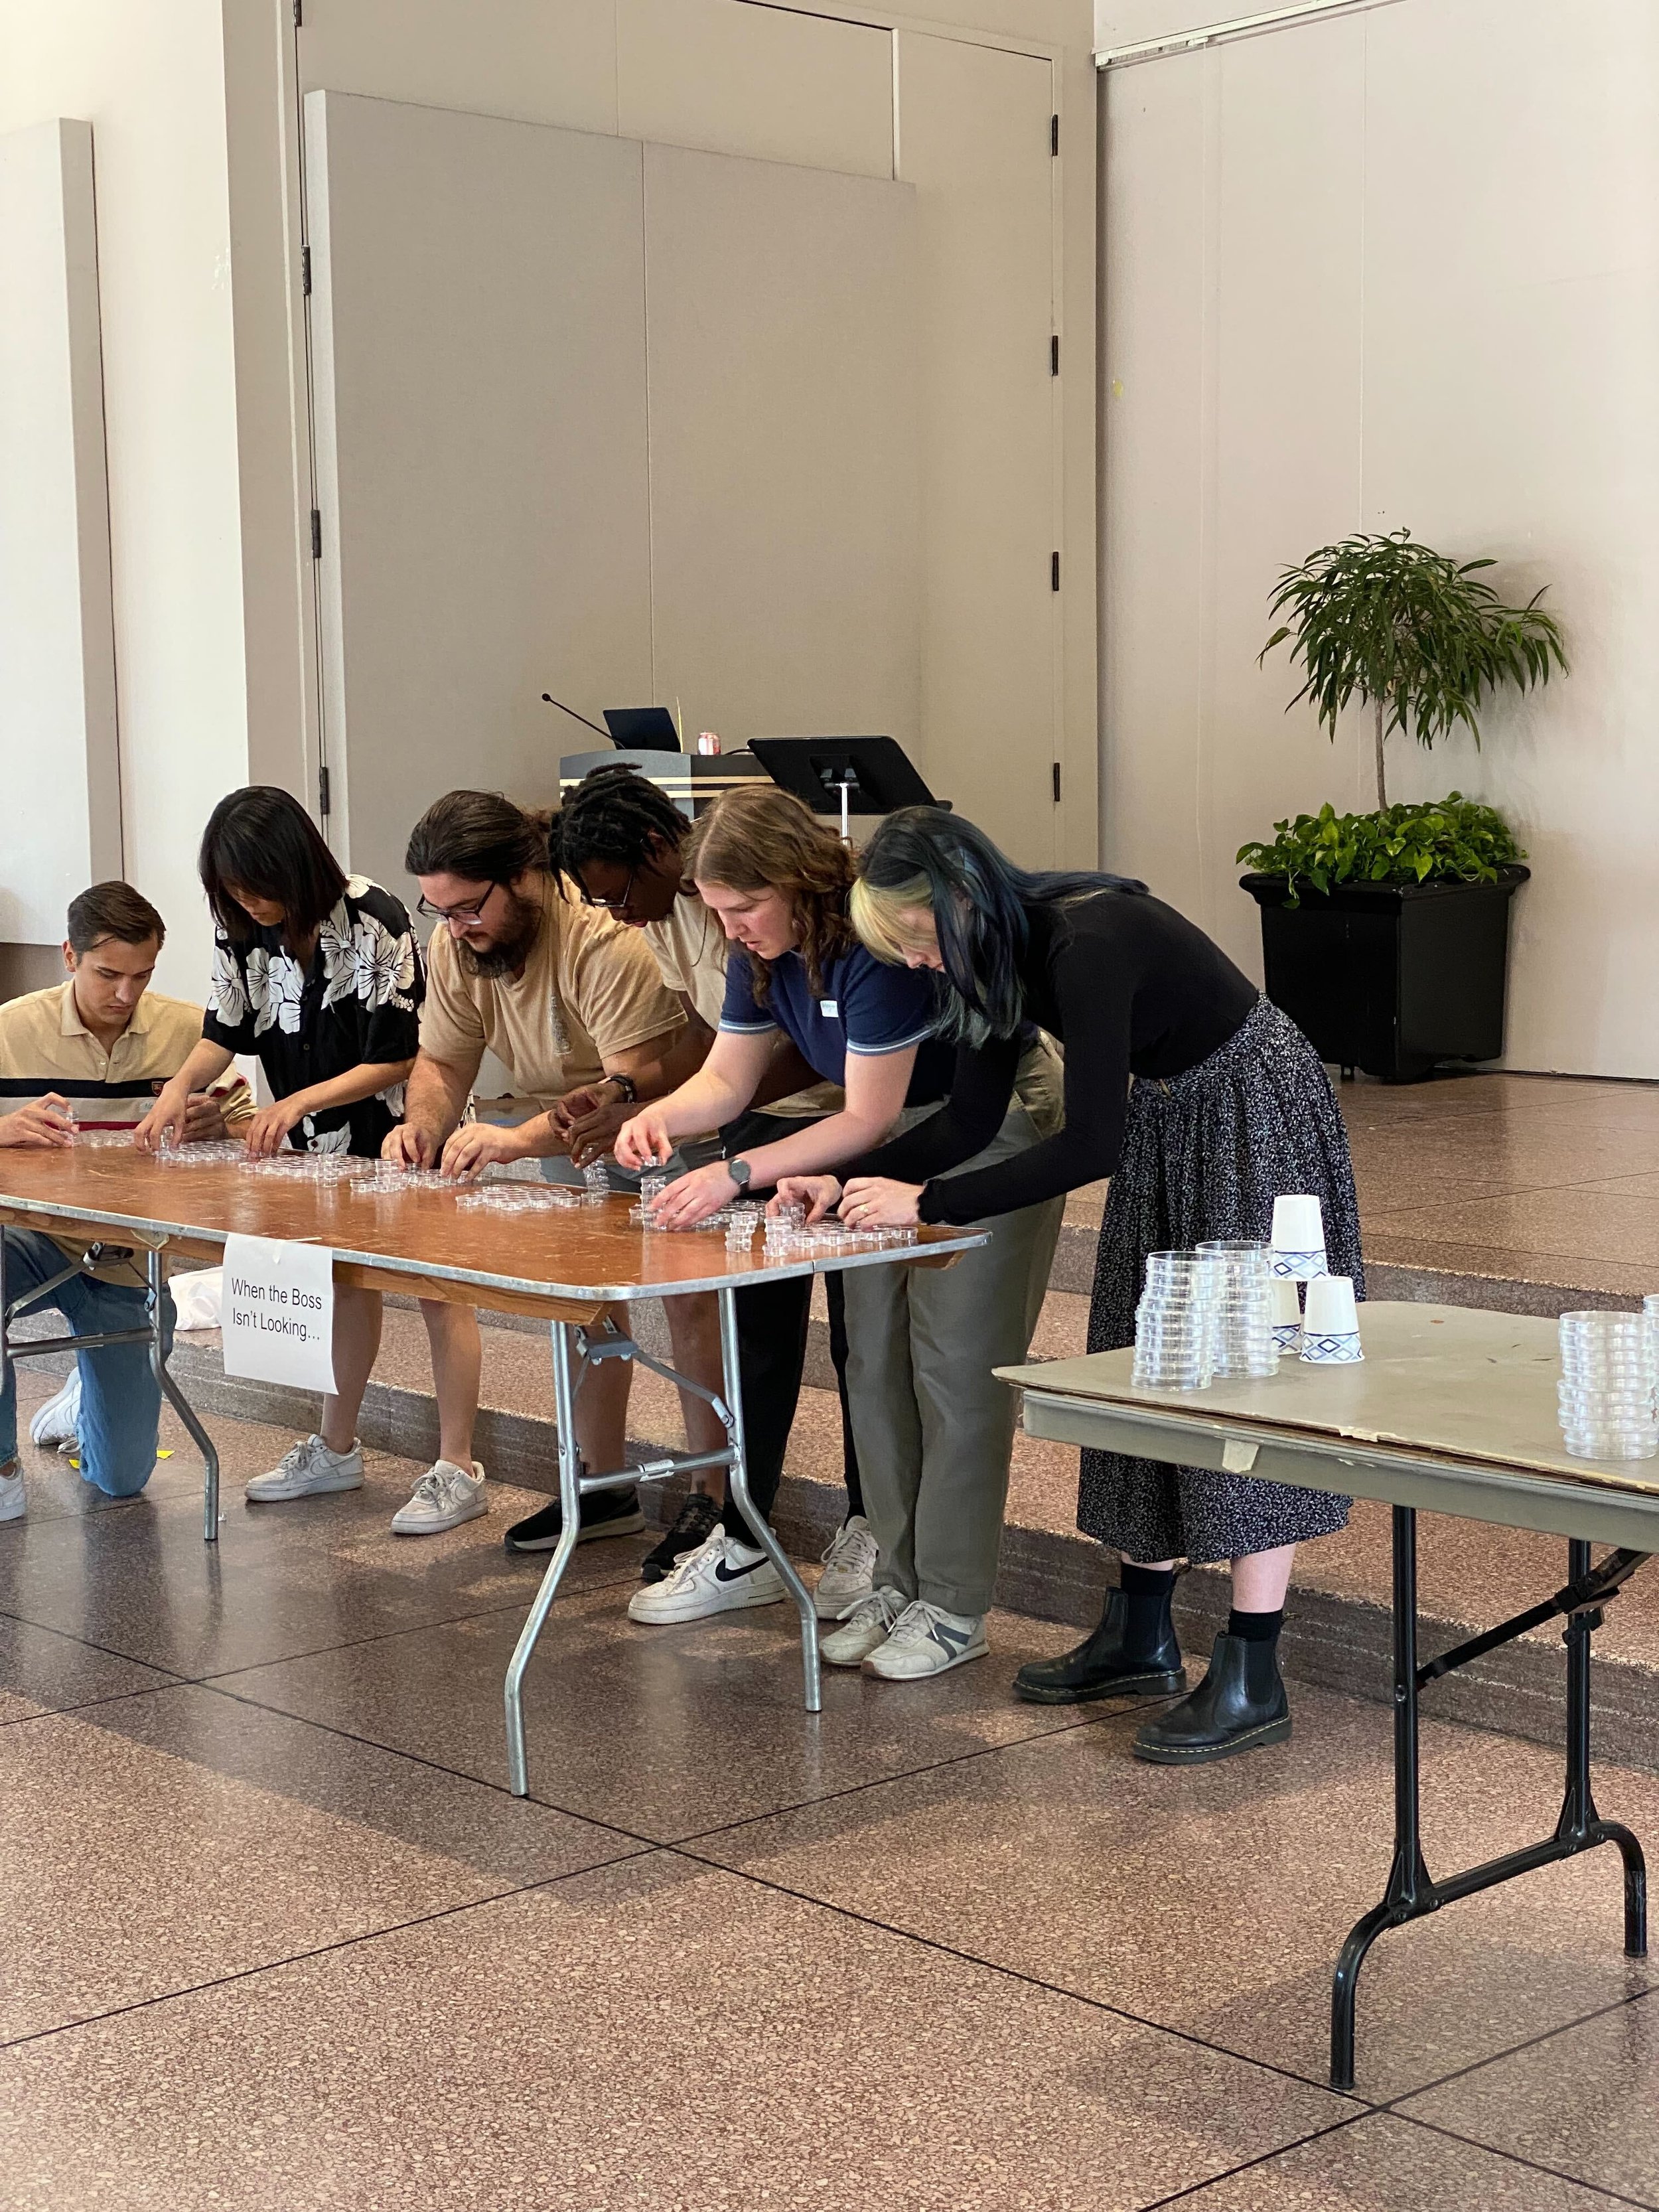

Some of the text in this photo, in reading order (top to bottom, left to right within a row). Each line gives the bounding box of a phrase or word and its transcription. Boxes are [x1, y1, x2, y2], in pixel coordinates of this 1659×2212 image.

[232, 1278, 322, 1309] When the Boss
[233, 1307, 320, 1341] Isn't Looking...
